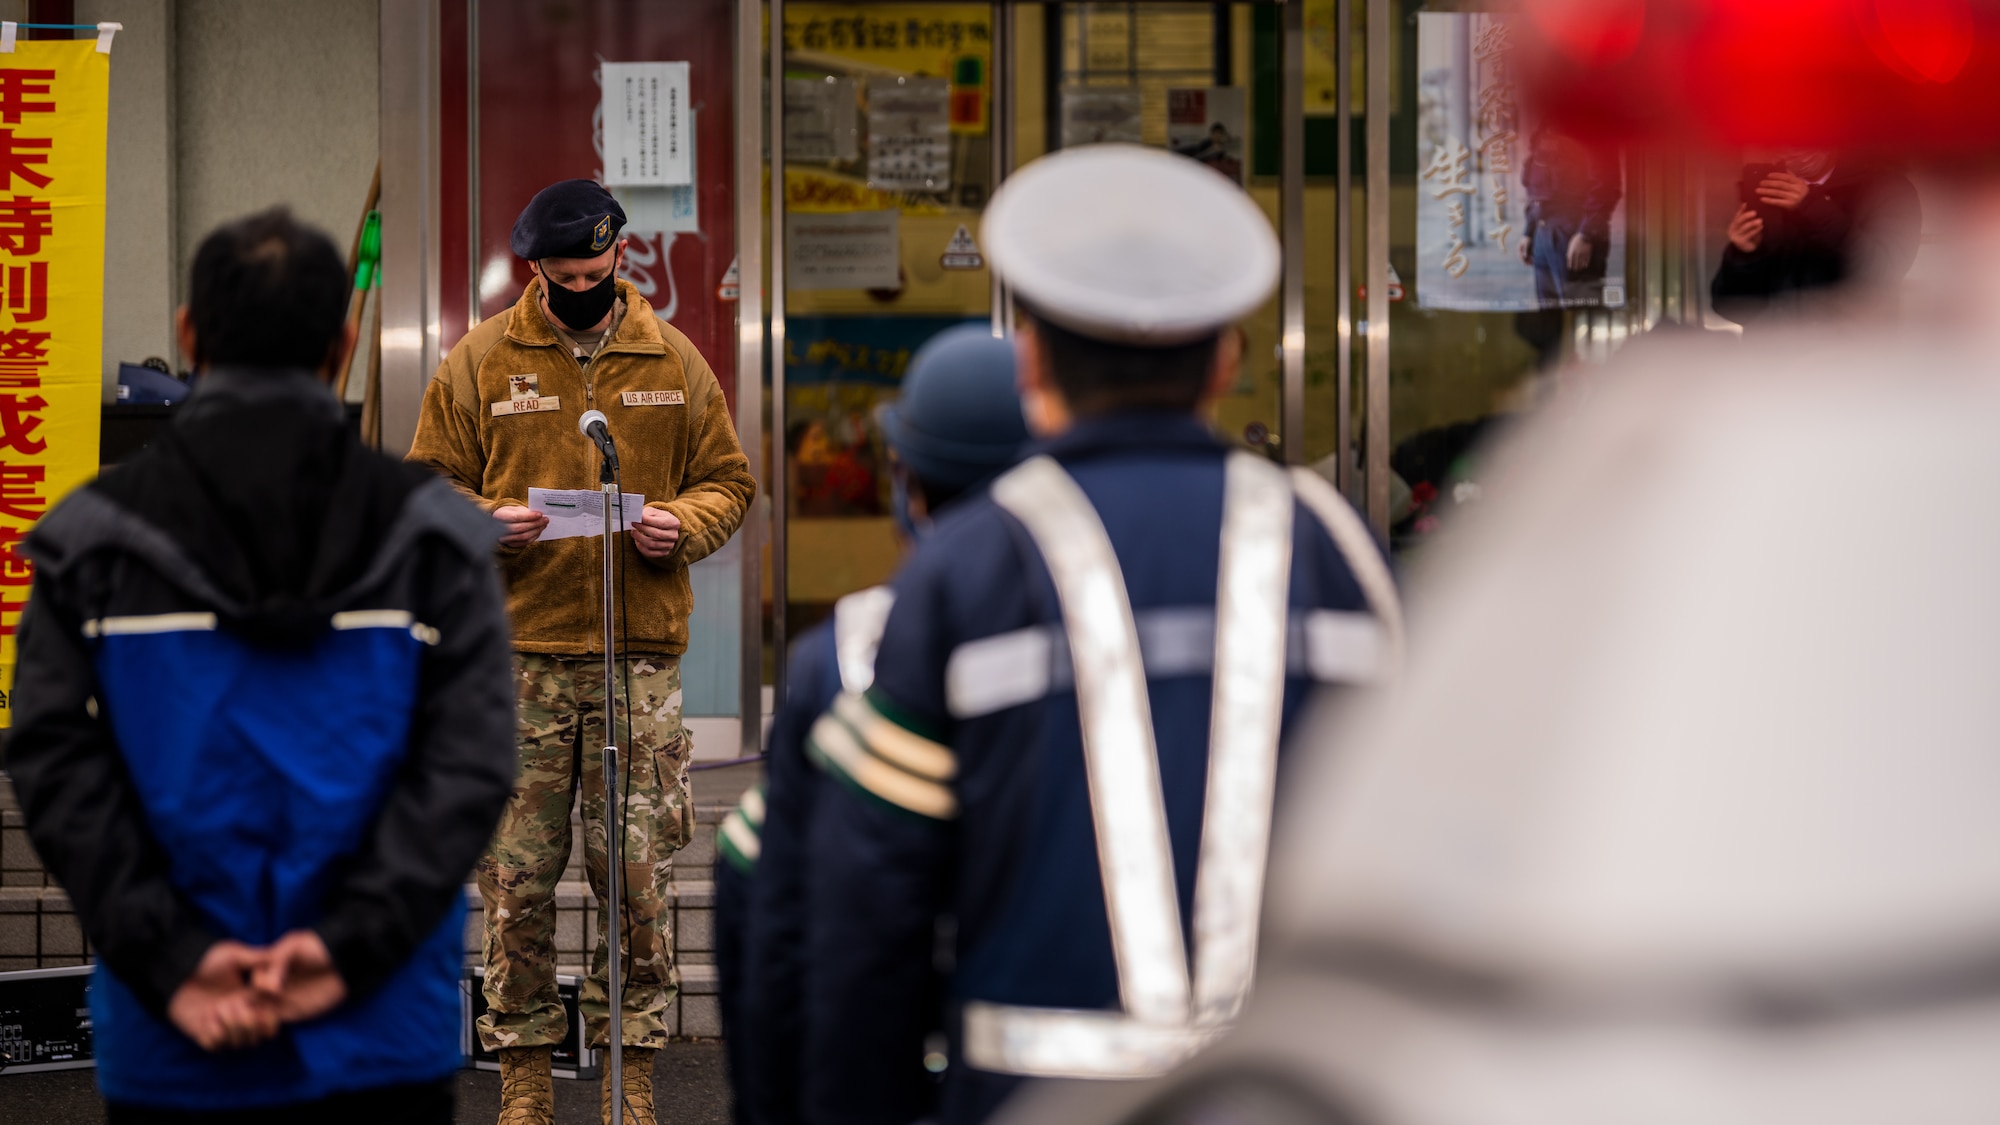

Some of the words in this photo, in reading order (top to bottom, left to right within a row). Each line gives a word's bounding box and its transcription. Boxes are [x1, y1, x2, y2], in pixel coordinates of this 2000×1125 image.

[1473, 21, 1519, 255] 警察官として
[1422, 135, 1477, 280] 生きる
[513, 399, 539, 412] READ
[641, 392, 653, 403] AIR
[654, 391, 682, 403] FORCE
